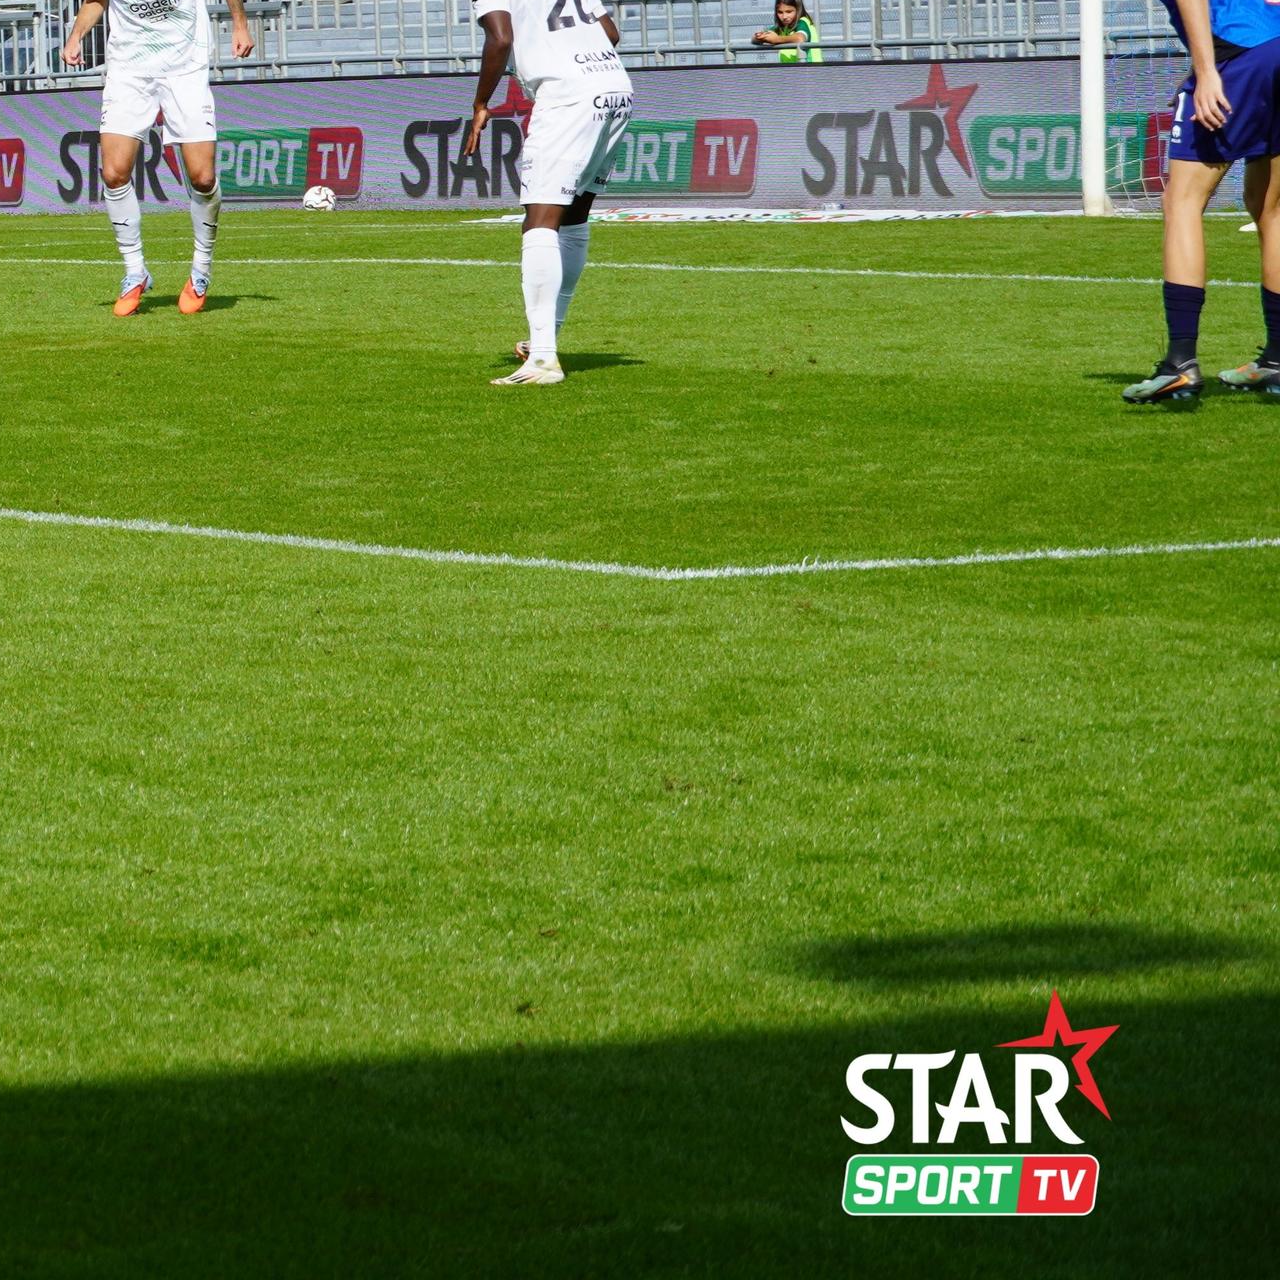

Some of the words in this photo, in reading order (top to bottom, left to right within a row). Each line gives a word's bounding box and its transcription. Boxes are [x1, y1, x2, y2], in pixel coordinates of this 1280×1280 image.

[138, 5, 175, 19] palace
[574, 50, 617, 65] CALLAN
[215, 139, 304, 187] PORT
[317, 142, 355, 181] TV
[400, 117, 521, 198] STAR
[610, 131, 690, 183] ORT
[703, 135, 749, 177] TV
[801, 108, 955, 198] STAR
[987, 125, 1138, 181] SPOT
